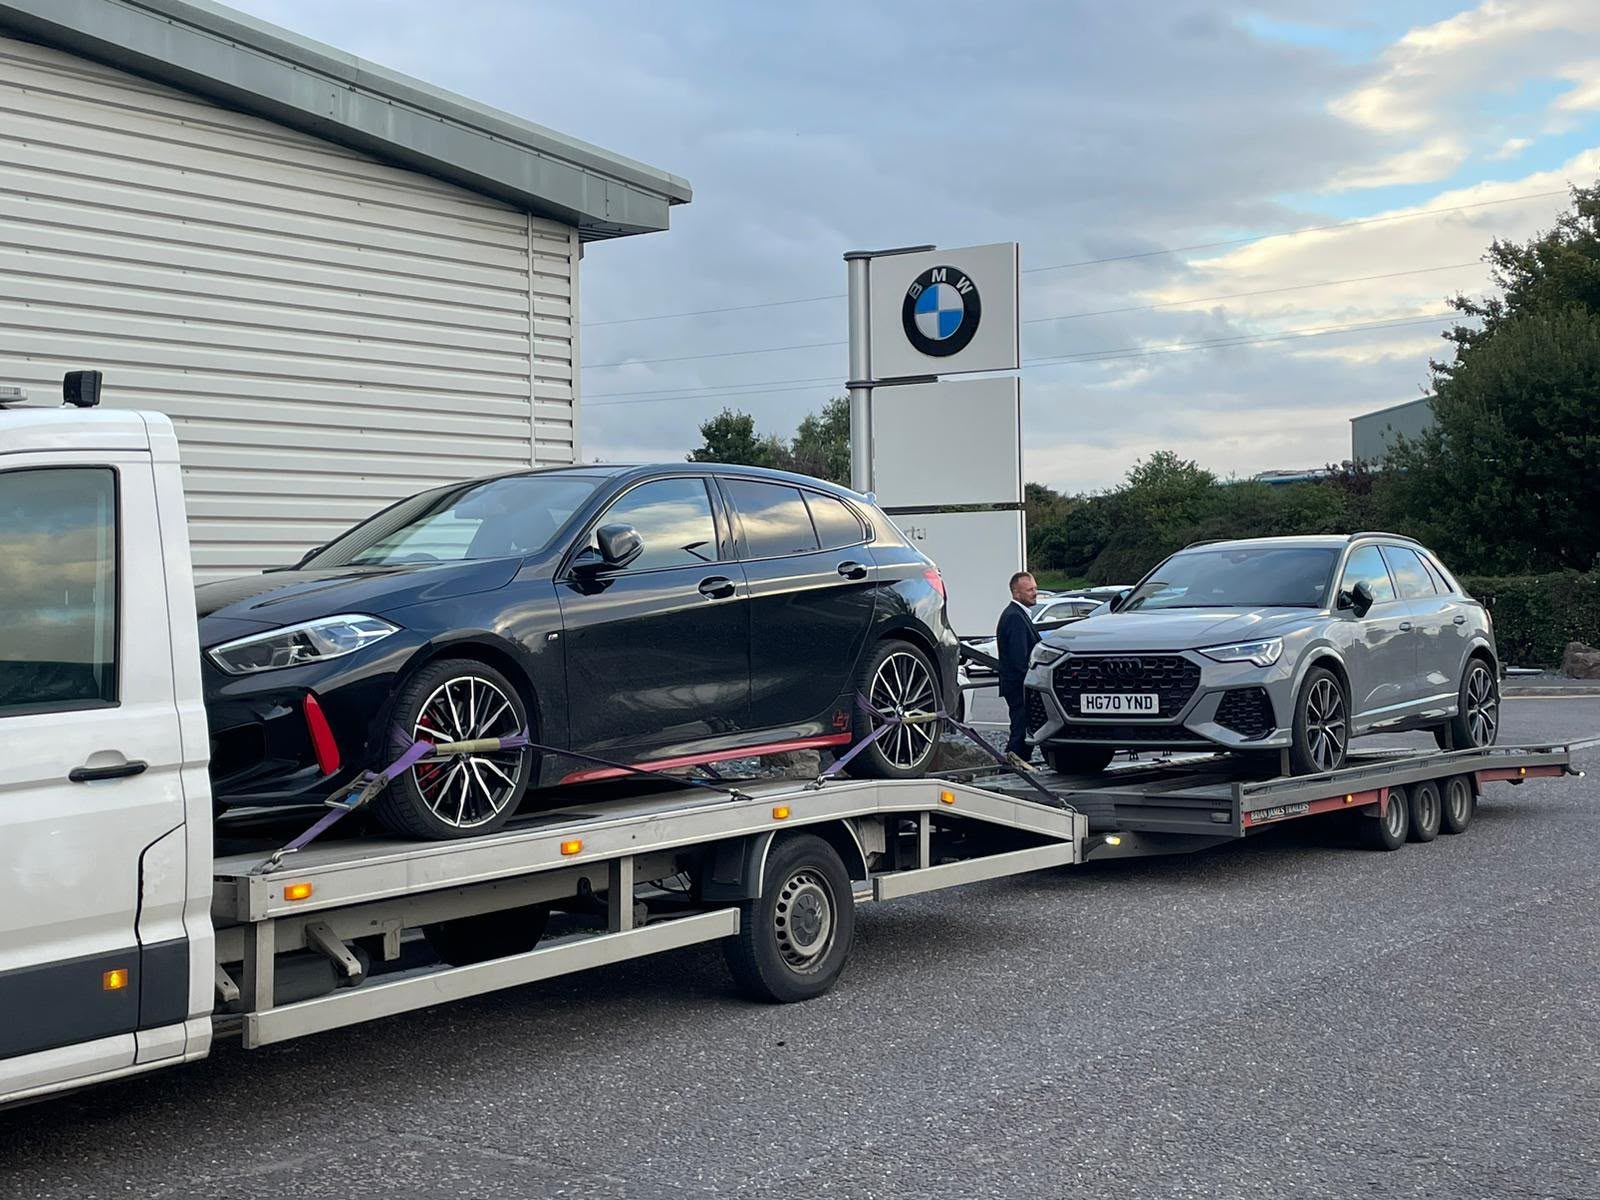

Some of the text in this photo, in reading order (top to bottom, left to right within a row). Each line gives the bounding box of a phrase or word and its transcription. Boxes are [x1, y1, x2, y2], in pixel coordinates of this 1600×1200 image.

[908, 268, 974, 300] BMW
[1086, 695, 1153, 710] HG70 YND
[1251, 802, 1310, 820] BRIAN JAMES TRAILERS
